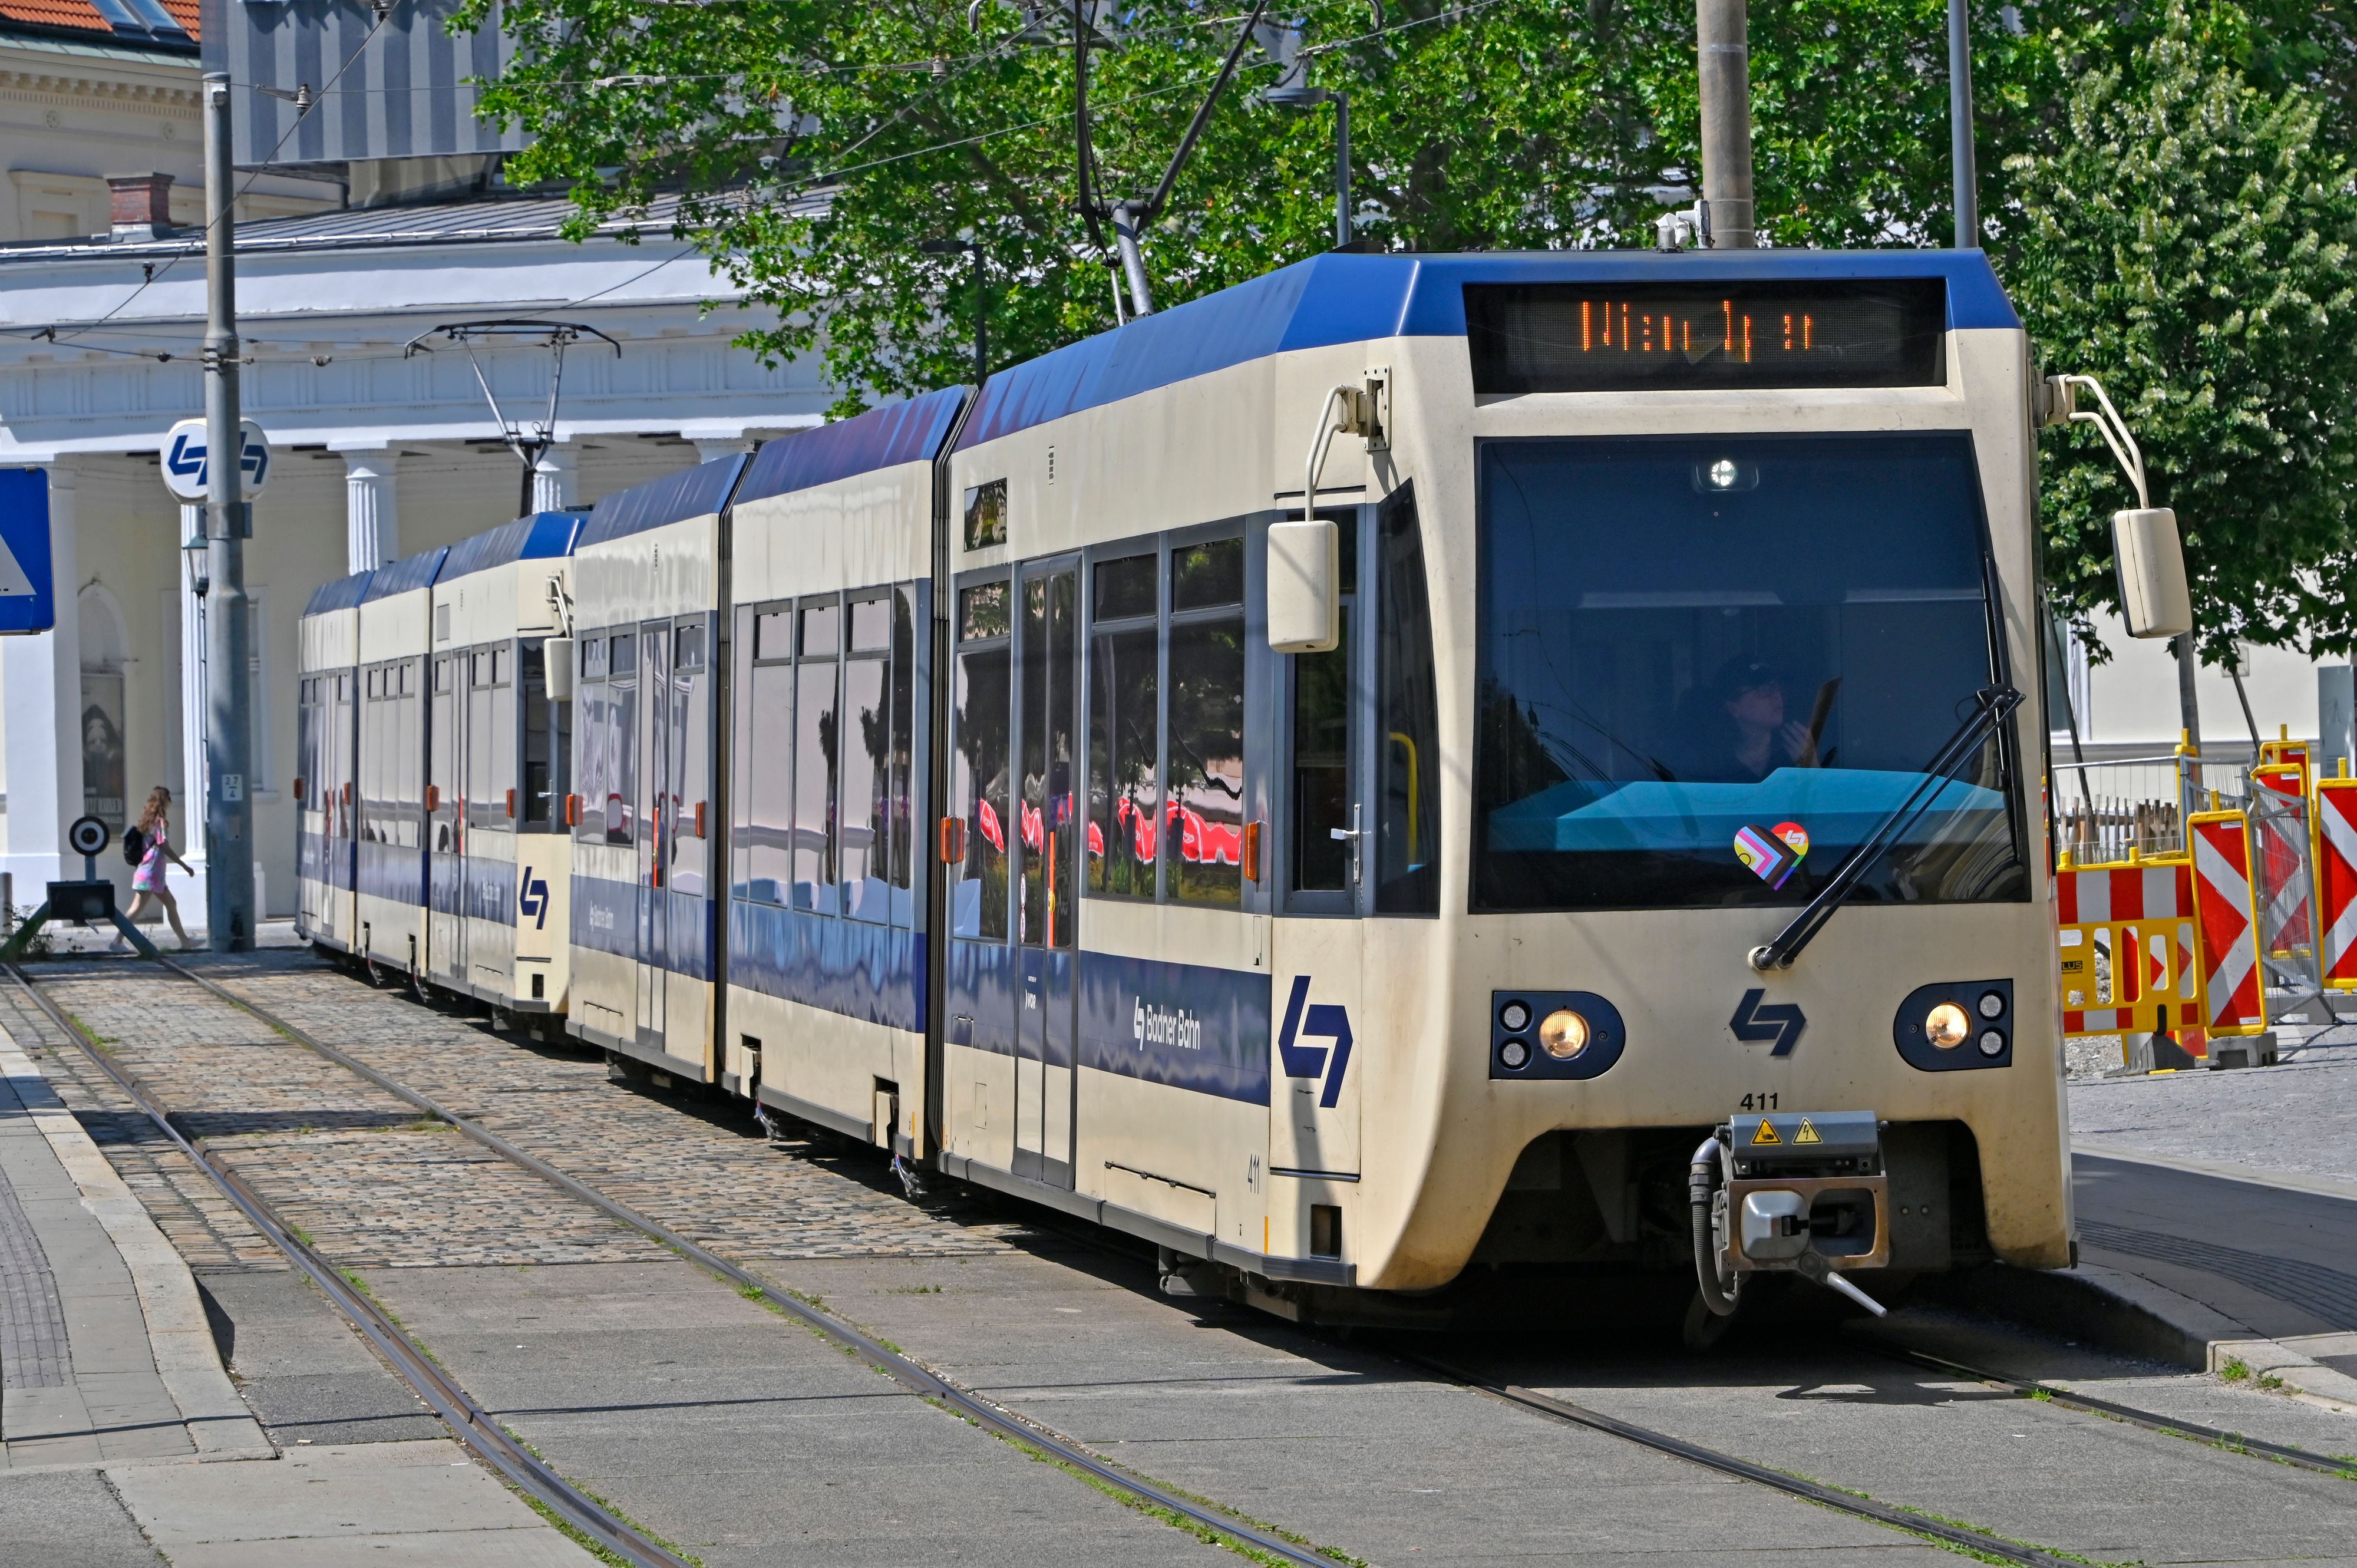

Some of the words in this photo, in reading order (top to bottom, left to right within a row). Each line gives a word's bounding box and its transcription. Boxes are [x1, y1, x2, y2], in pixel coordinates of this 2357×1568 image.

[1028, 992, 1036, 1009] VOR
[1147, 1003, 1177, 1046] Badner
[1178, 1009, 1200, 1051] Bahn
[1740, 1092, 1778, 1111] 411
[1247, 1154, 1260, 1195] 411
